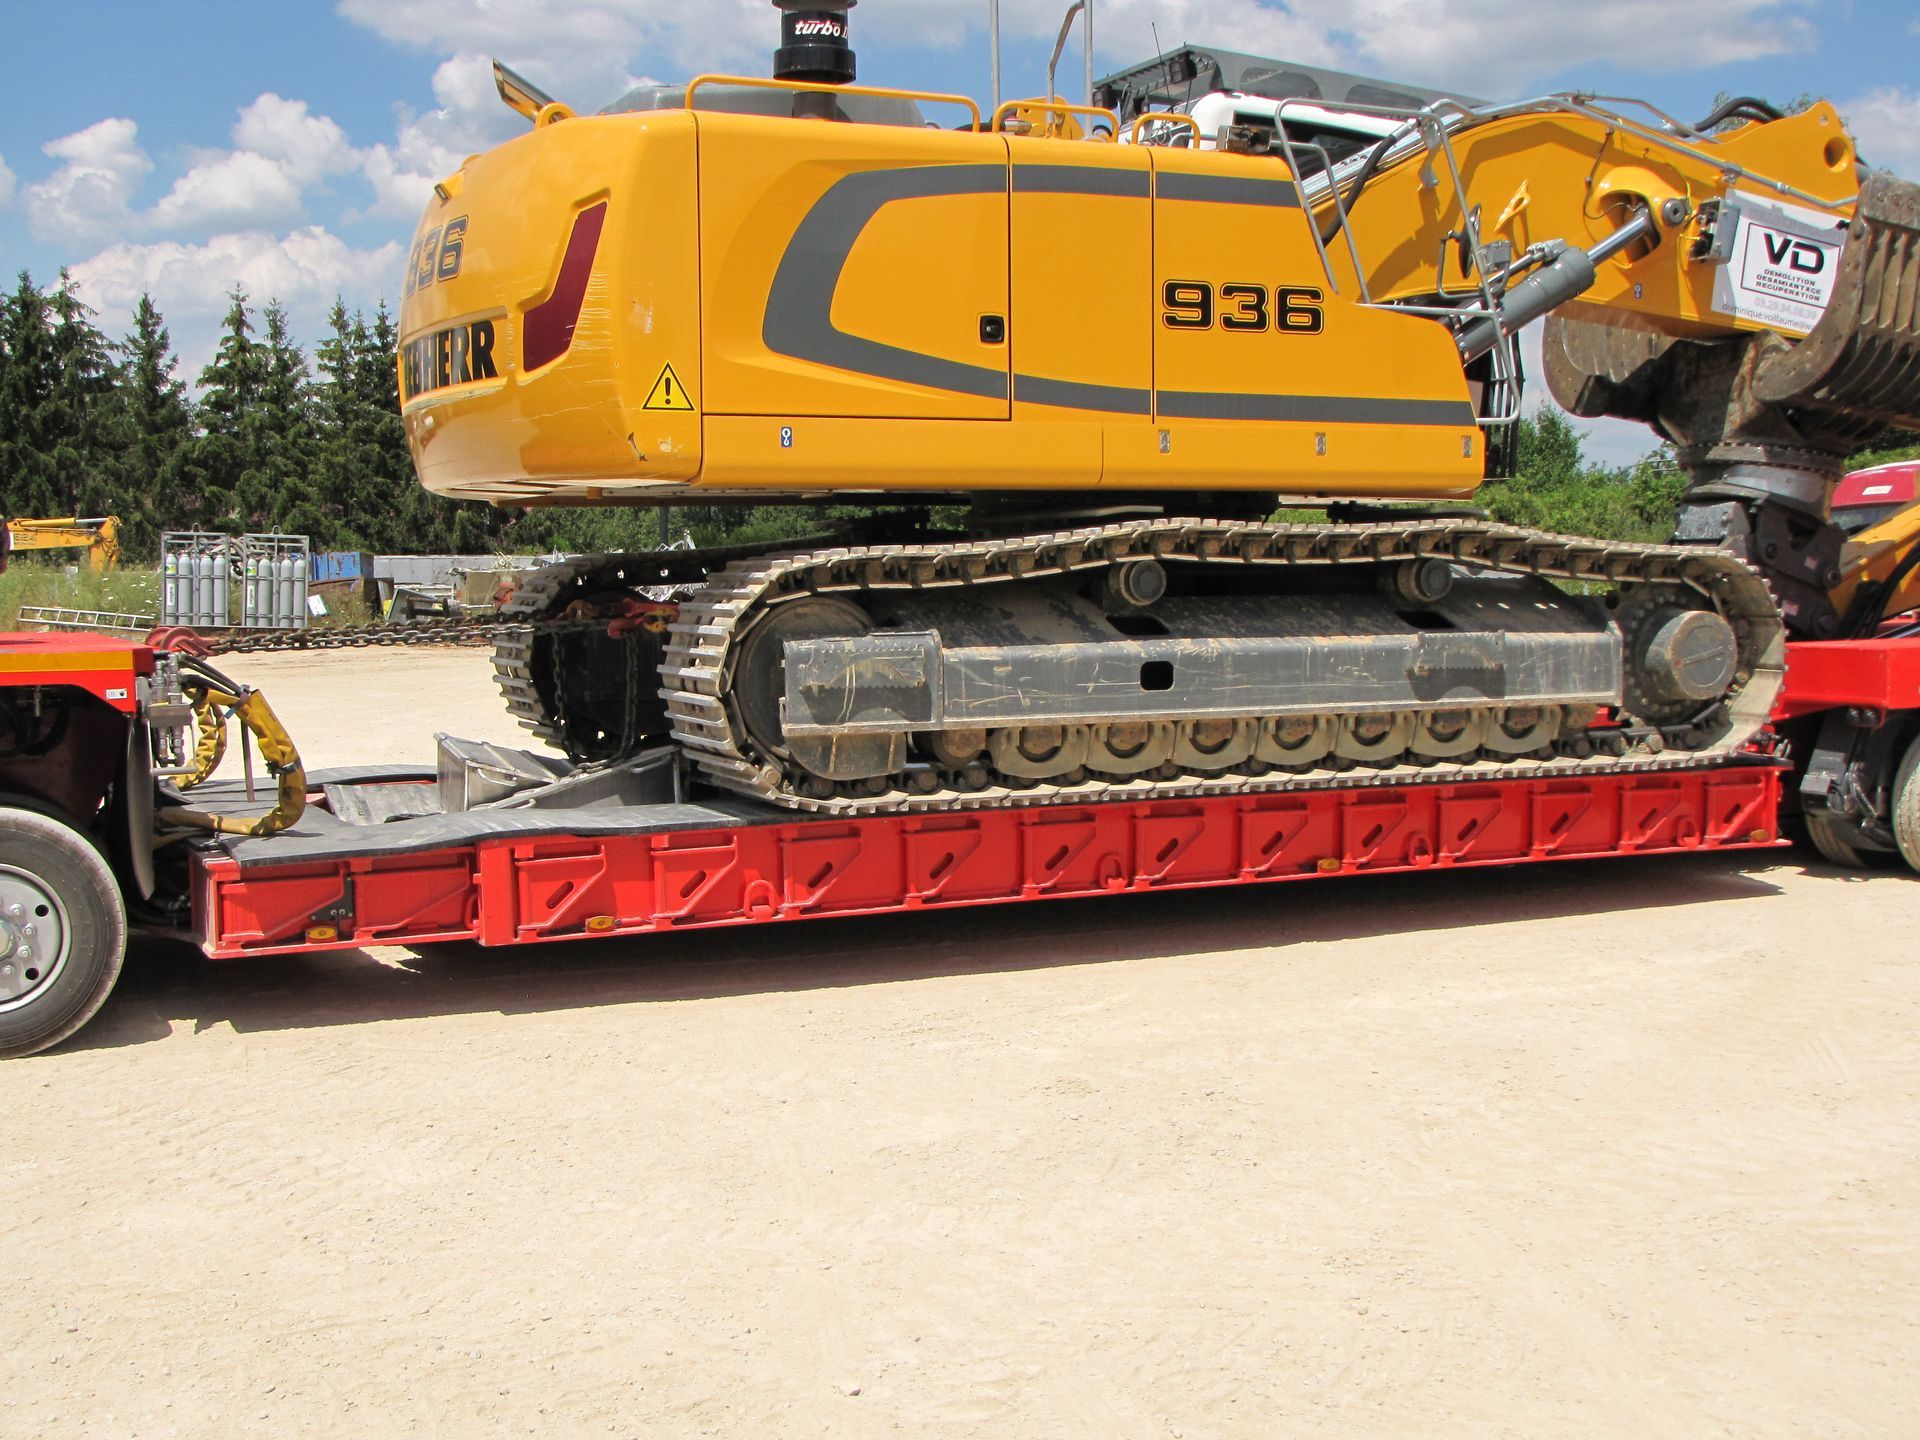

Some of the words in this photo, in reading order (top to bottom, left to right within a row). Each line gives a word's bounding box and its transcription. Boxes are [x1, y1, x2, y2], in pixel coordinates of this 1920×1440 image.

[794, 19, 841, 37] turbo
[1763, 232, 1825, 275] VD
[1756, 274, 1821, 295] DESAMIANTAGE
[1764, 269, 1816, 286] DEMOLITION
[1755, 282, 1820, 301] RECUPERATION
[1162, 279, 1324, 335] 936
[1722, 302, 1813, 331] dominique.voillaume@w
